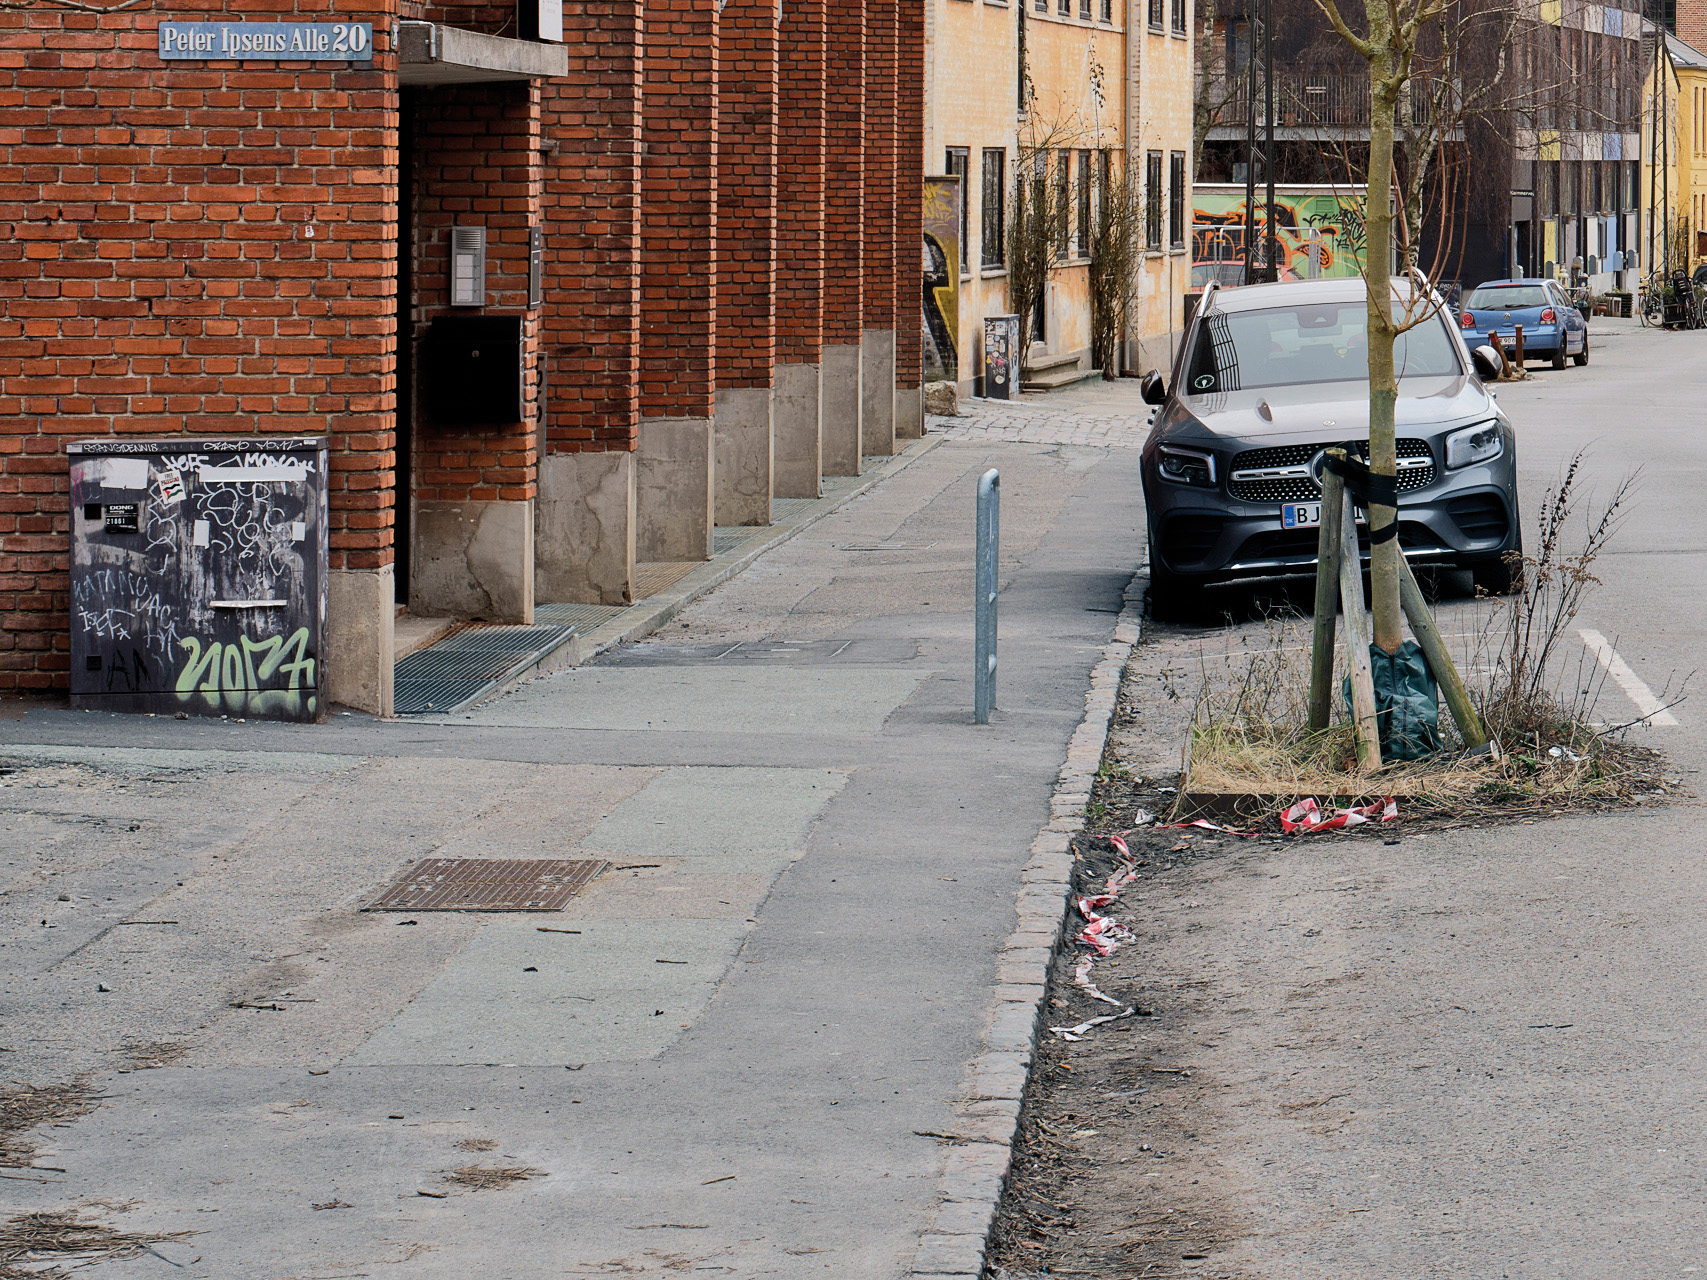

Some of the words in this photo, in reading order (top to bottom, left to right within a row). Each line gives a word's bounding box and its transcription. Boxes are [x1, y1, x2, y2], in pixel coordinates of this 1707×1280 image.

[163, 27, 216, 53] Peter
[221, 27, 287, 57] Ipsens
[290, 27, 329, 53] Alle
[332, 24, 367, 53] 20
[1297, 506, 1320, 523] BJ
